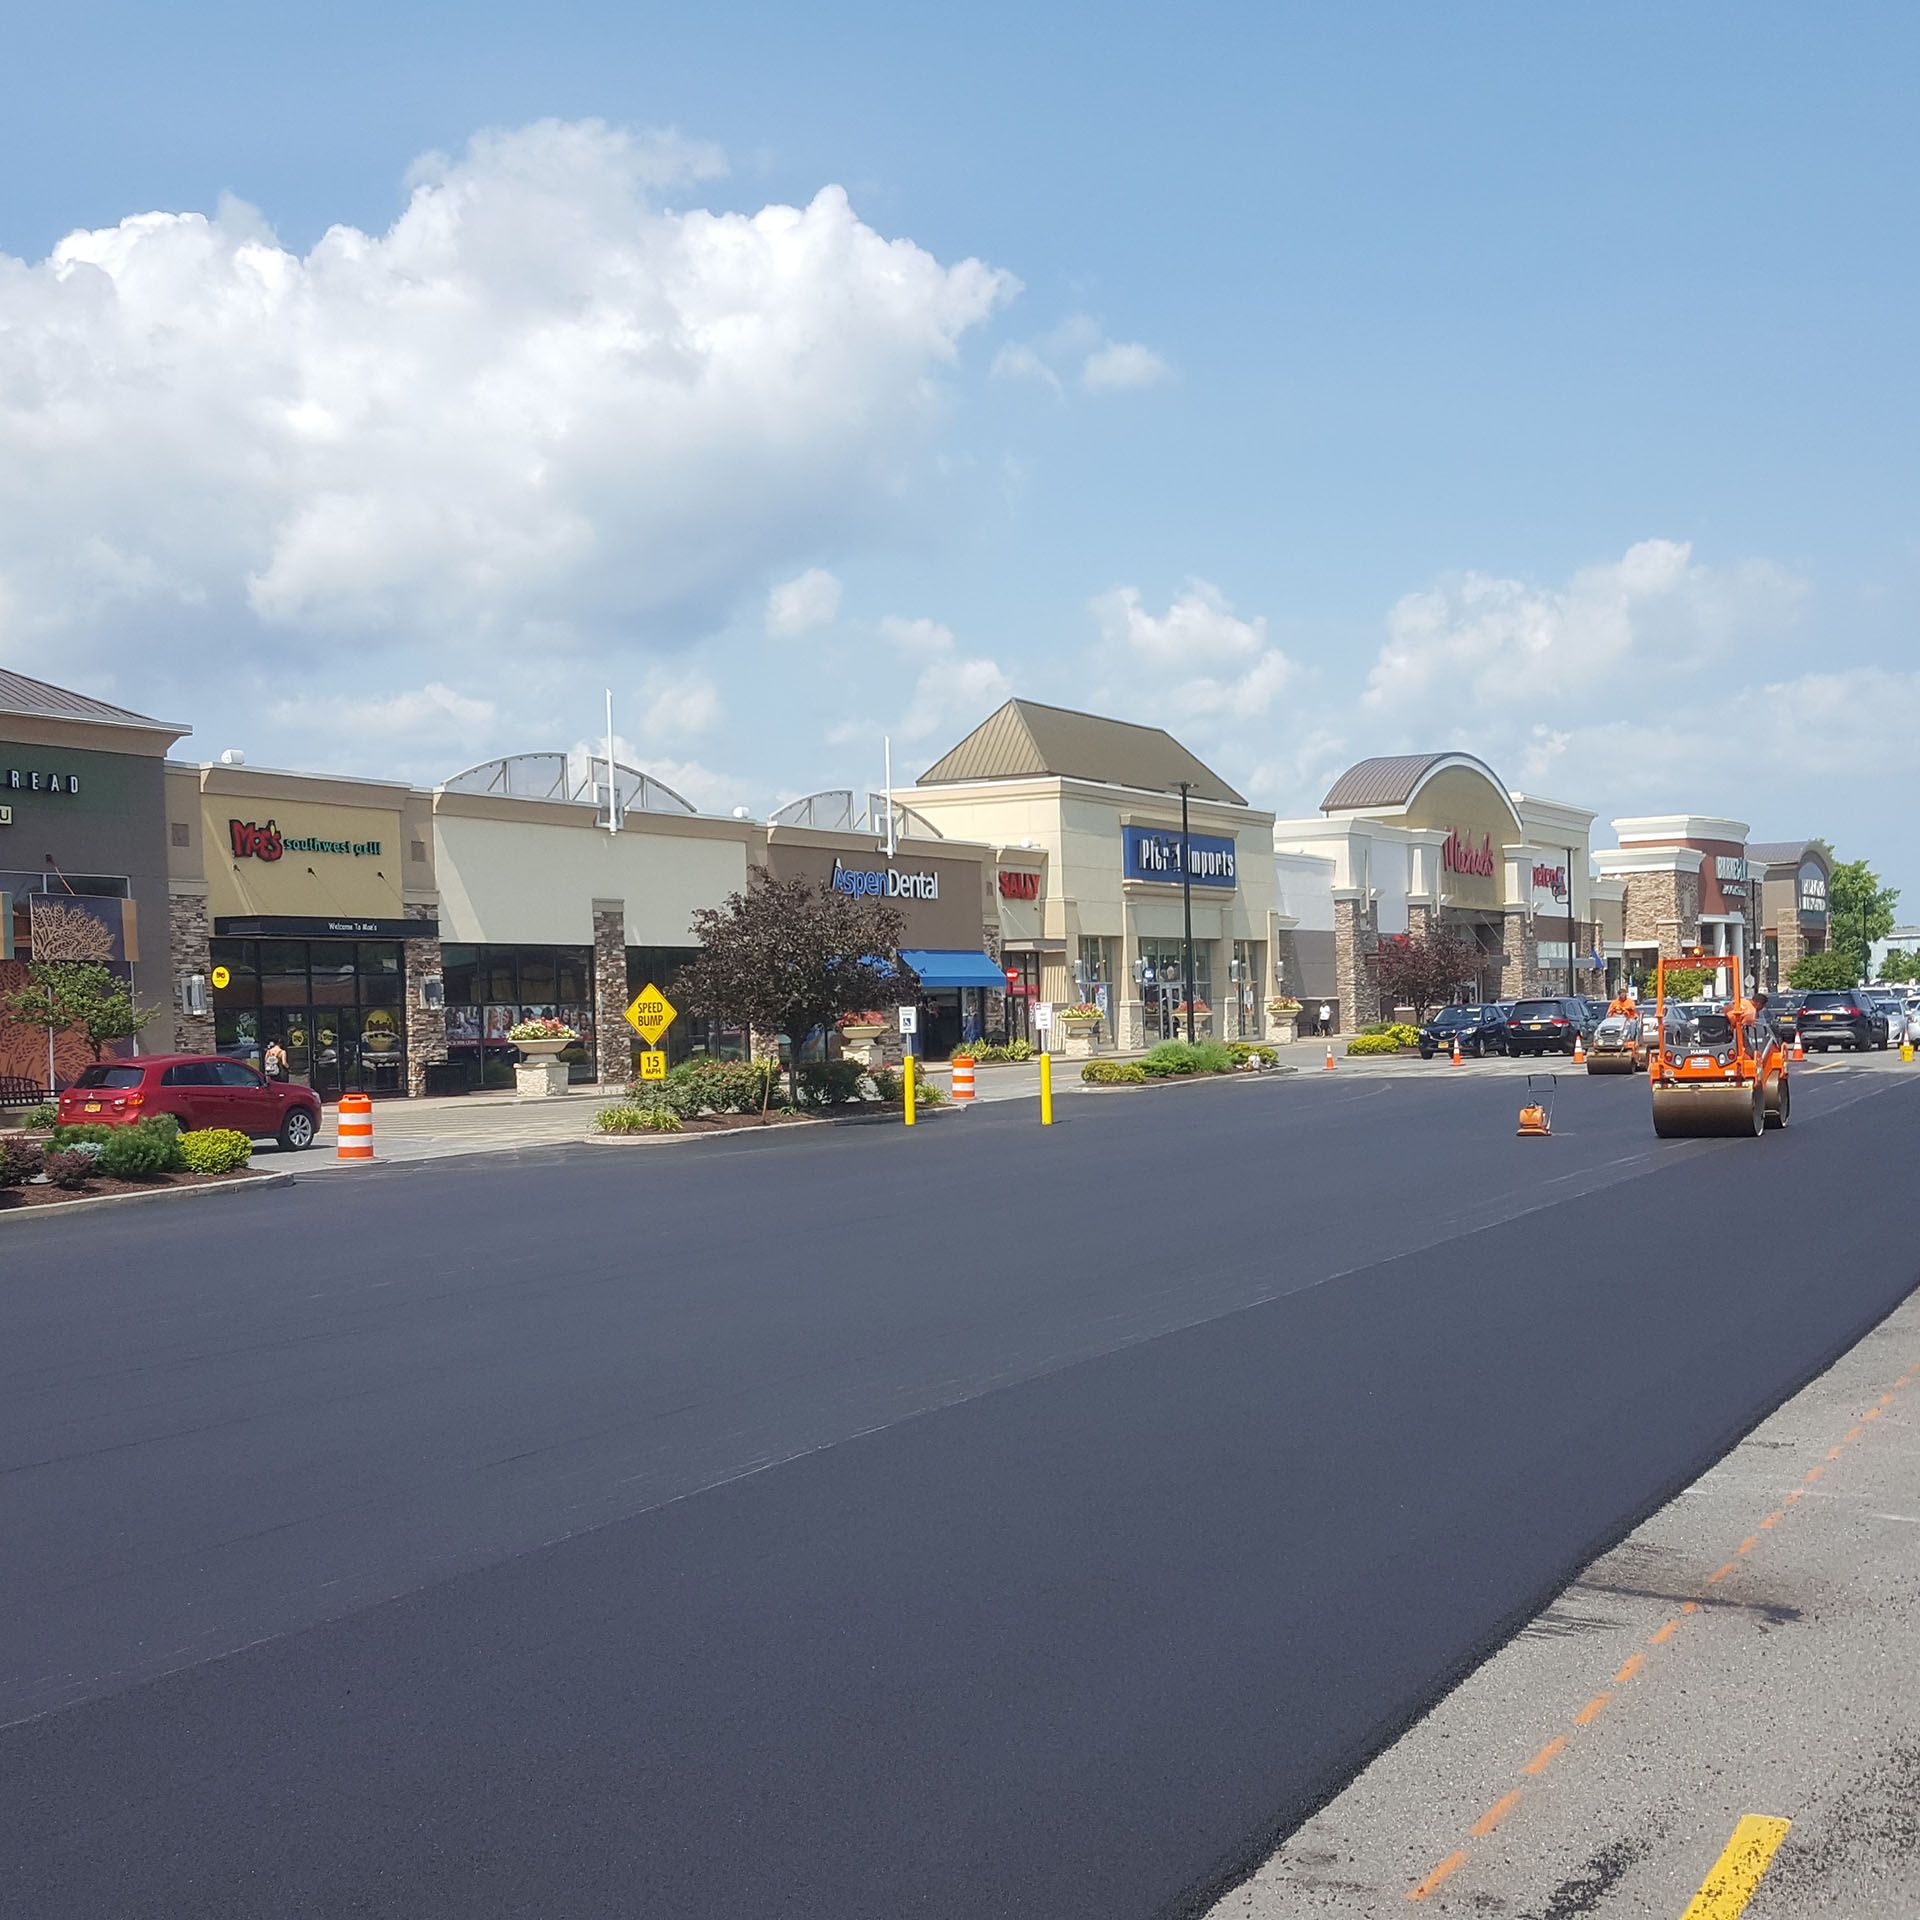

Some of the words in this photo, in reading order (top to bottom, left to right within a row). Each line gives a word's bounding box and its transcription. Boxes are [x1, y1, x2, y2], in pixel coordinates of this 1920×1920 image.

[229, 819, 283, 862] Moe's
[283, 837, 350, 854] southwest
[353, 841, 381, 857] grill
[1141, 838, 1170, 871] Pier
[1187, 843, 1234, 878] Imports
[1442, 825, 1495, 877] Michaels
[999, 871, 1040, 900] SALLY
[328, 923, 353, 931] Welcome
[354, 923, 361, 931] To
[637, 1002, 663, 1014] SPEED
[637, 1015, 664, 1027] BUMP
[646, 1056, 660, 1068] 15
